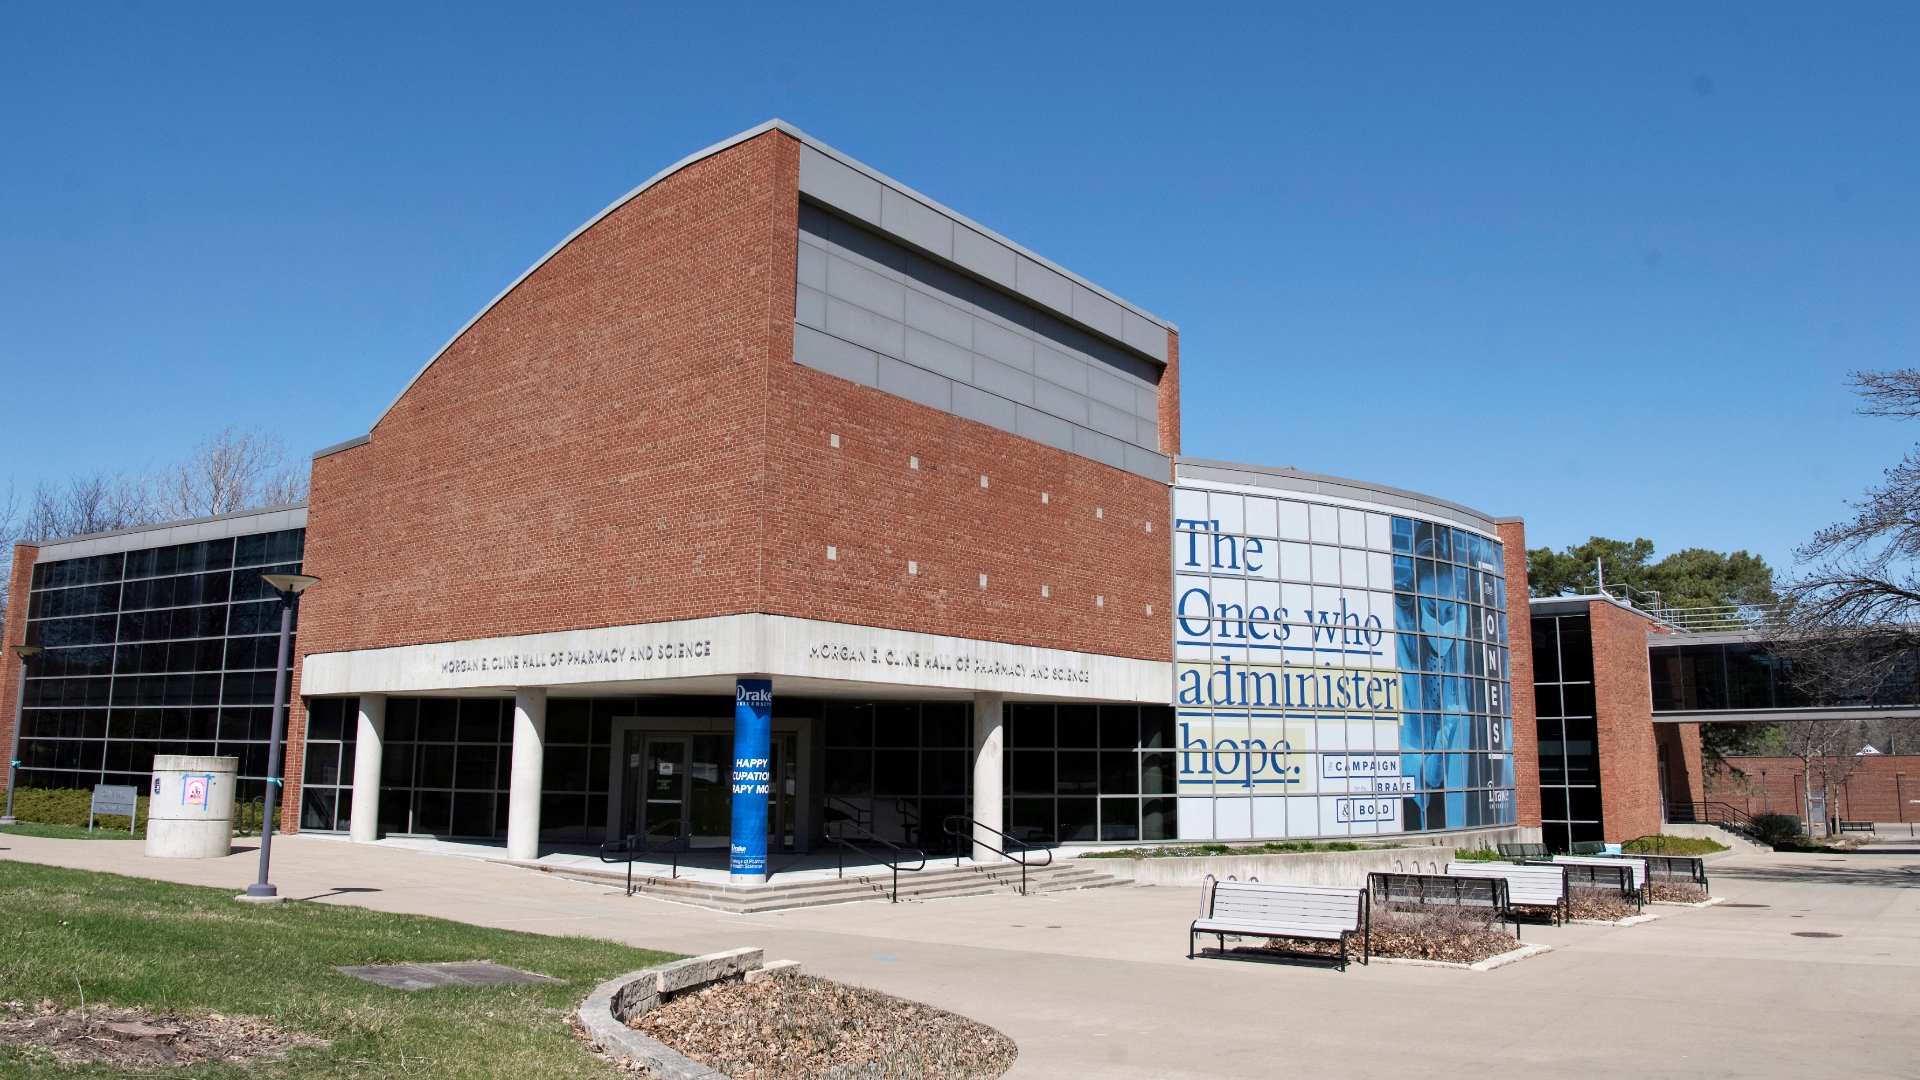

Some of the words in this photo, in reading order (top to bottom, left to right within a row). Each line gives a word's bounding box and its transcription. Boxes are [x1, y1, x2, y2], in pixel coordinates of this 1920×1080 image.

[1175, 518, 1263, 572] The
[1178, 587, 1290, 642] Ones
[1303, 597, 1382, 647] who
[441, 659, 478, 673] MORGAN
[481, 657, 489, 671] E.
[492, 655, 519, 670] CLINE
[522, 653, 546, 668] HALL
[549, 651, 564, 666] OF
[567, 647, 626, 665] PHARMACY
[629, 645, 653, 662] AND
[657, 640, 711, 659] SCIENCE
[809, 643, 866, 662] MORGAN
[885, 648, 920, 668] CLINE
[924, 654, 952, 671] HALL
[956, 657, 970, 672] OF
[974, 658, 1027, 677] PHARMACY
[1030, 667, 1049, 680] AND
[1052, 668, 1089, 683] SCIENCE
[736, 685, 772, 701] Drake
[1178, 655, 1398, 710] administer
[1486, 614, 1500, 744] ONES
[735, 758, 768, 768] HAPPY
[1178, 722, 1301, 788] hope.
[1335, 760, 1397, 772] CAMPAIGN
[732, 771, 770, 781] CUPATIO
[1342, 803, 1350, 816] &
